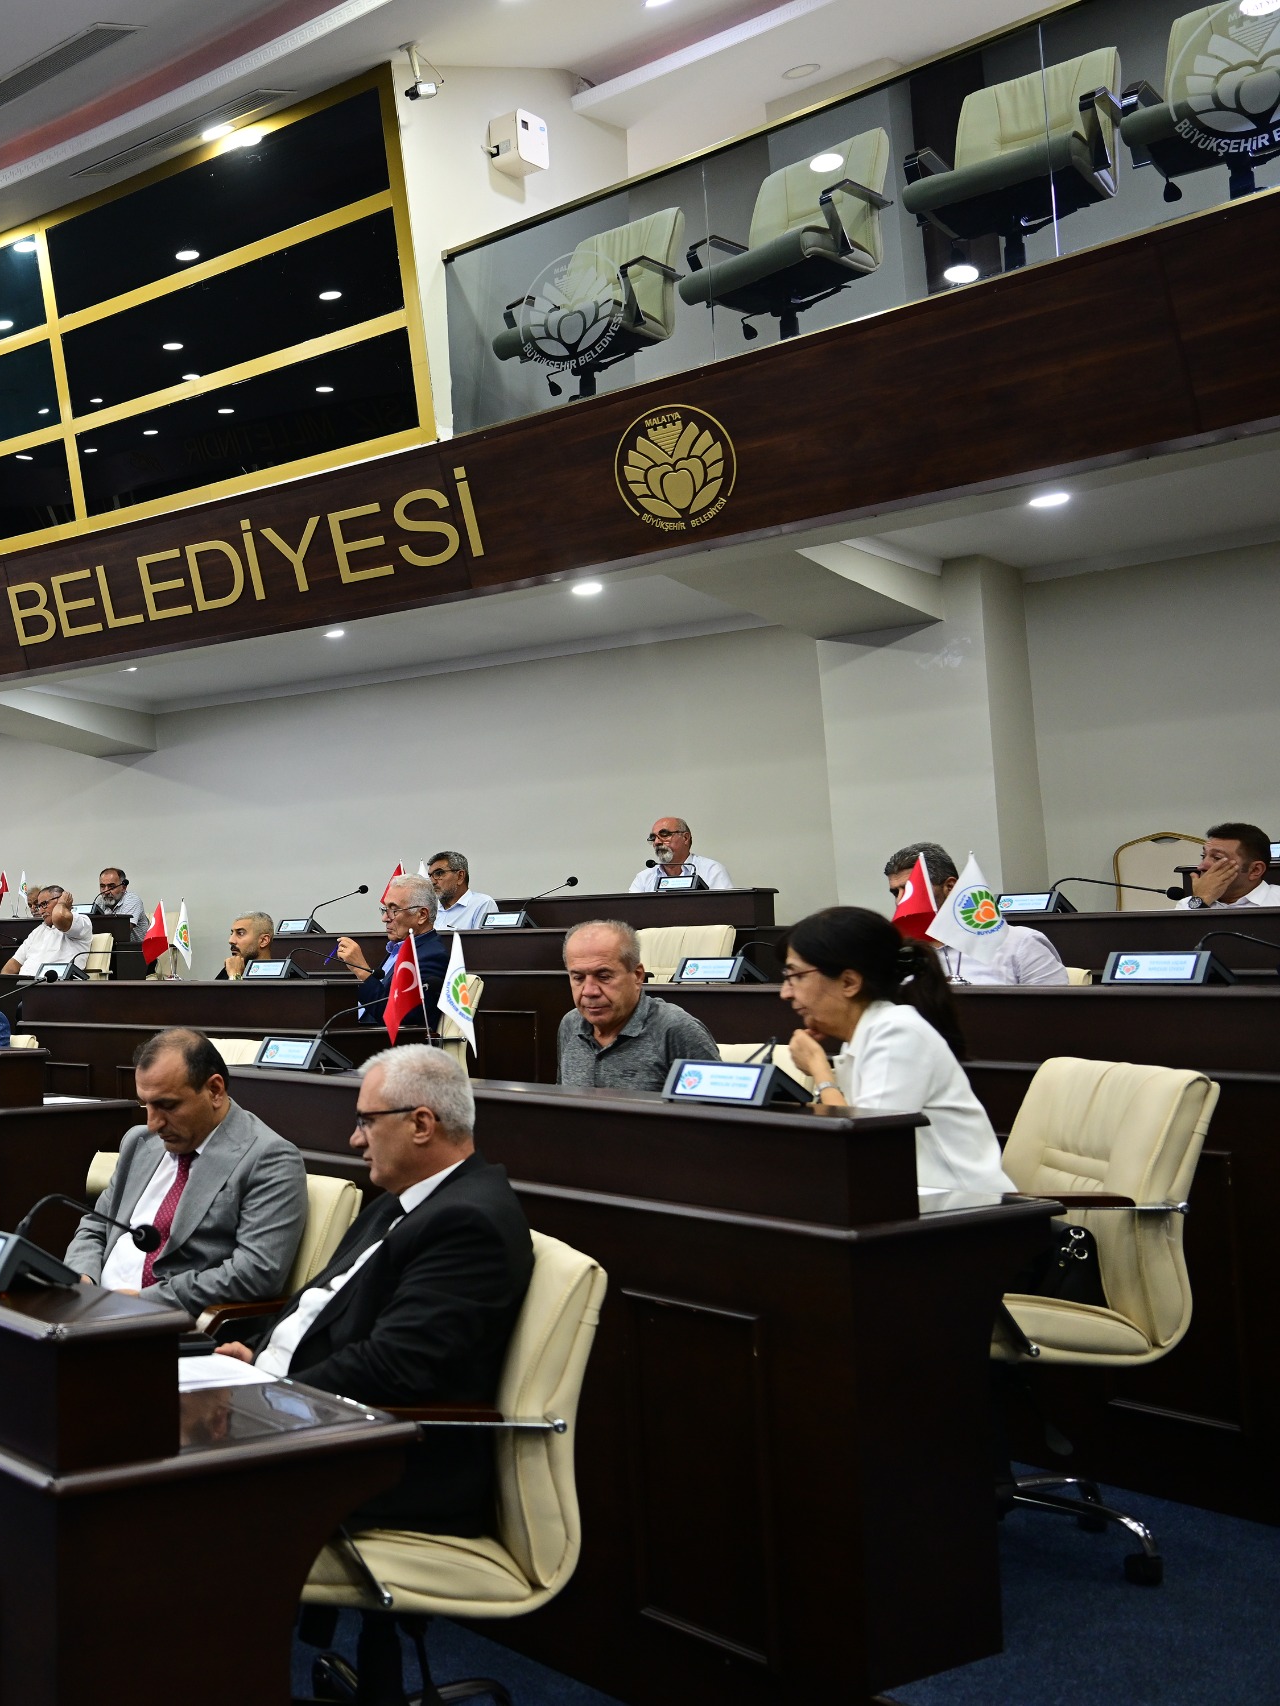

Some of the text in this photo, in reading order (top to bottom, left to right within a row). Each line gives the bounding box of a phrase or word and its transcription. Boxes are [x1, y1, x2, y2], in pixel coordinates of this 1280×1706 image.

[1174, 118, 1269, 156] BÜYÜKŞEHİR
[578, 313, 624, 366] BELEDİYESİ
[644, 411, 682, 428] MALATYA
[641, 496, 727, 532] BÜYÜKŞEHİR BELEDİYESİ
[7, 466, 485, 647] BELEDİYESİ
